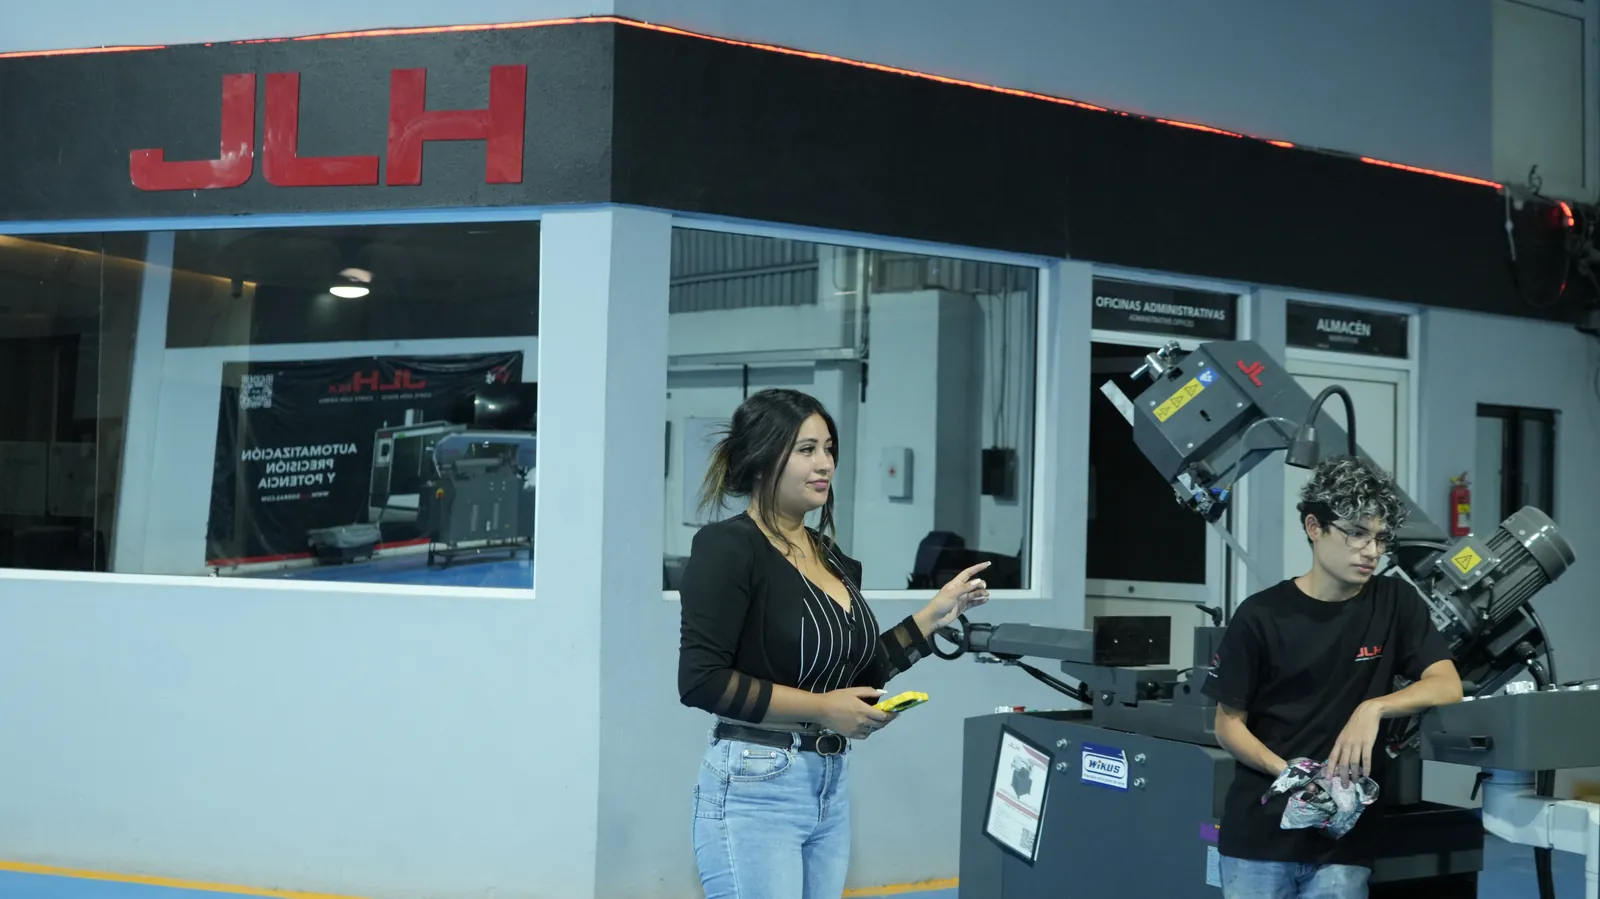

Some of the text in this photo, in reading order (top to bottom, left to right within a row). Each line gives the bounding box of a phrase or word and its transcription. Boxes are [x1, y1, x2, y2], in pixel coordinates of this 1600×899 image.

[129, 64, 527, 191] JLH
[1095, 296, 1226, 320] OFICINAS ADMINISTRATIVAS
[1316, 318, 1371, 337] ALMACÉN
[1356, 645, 1383, 658] JLH
